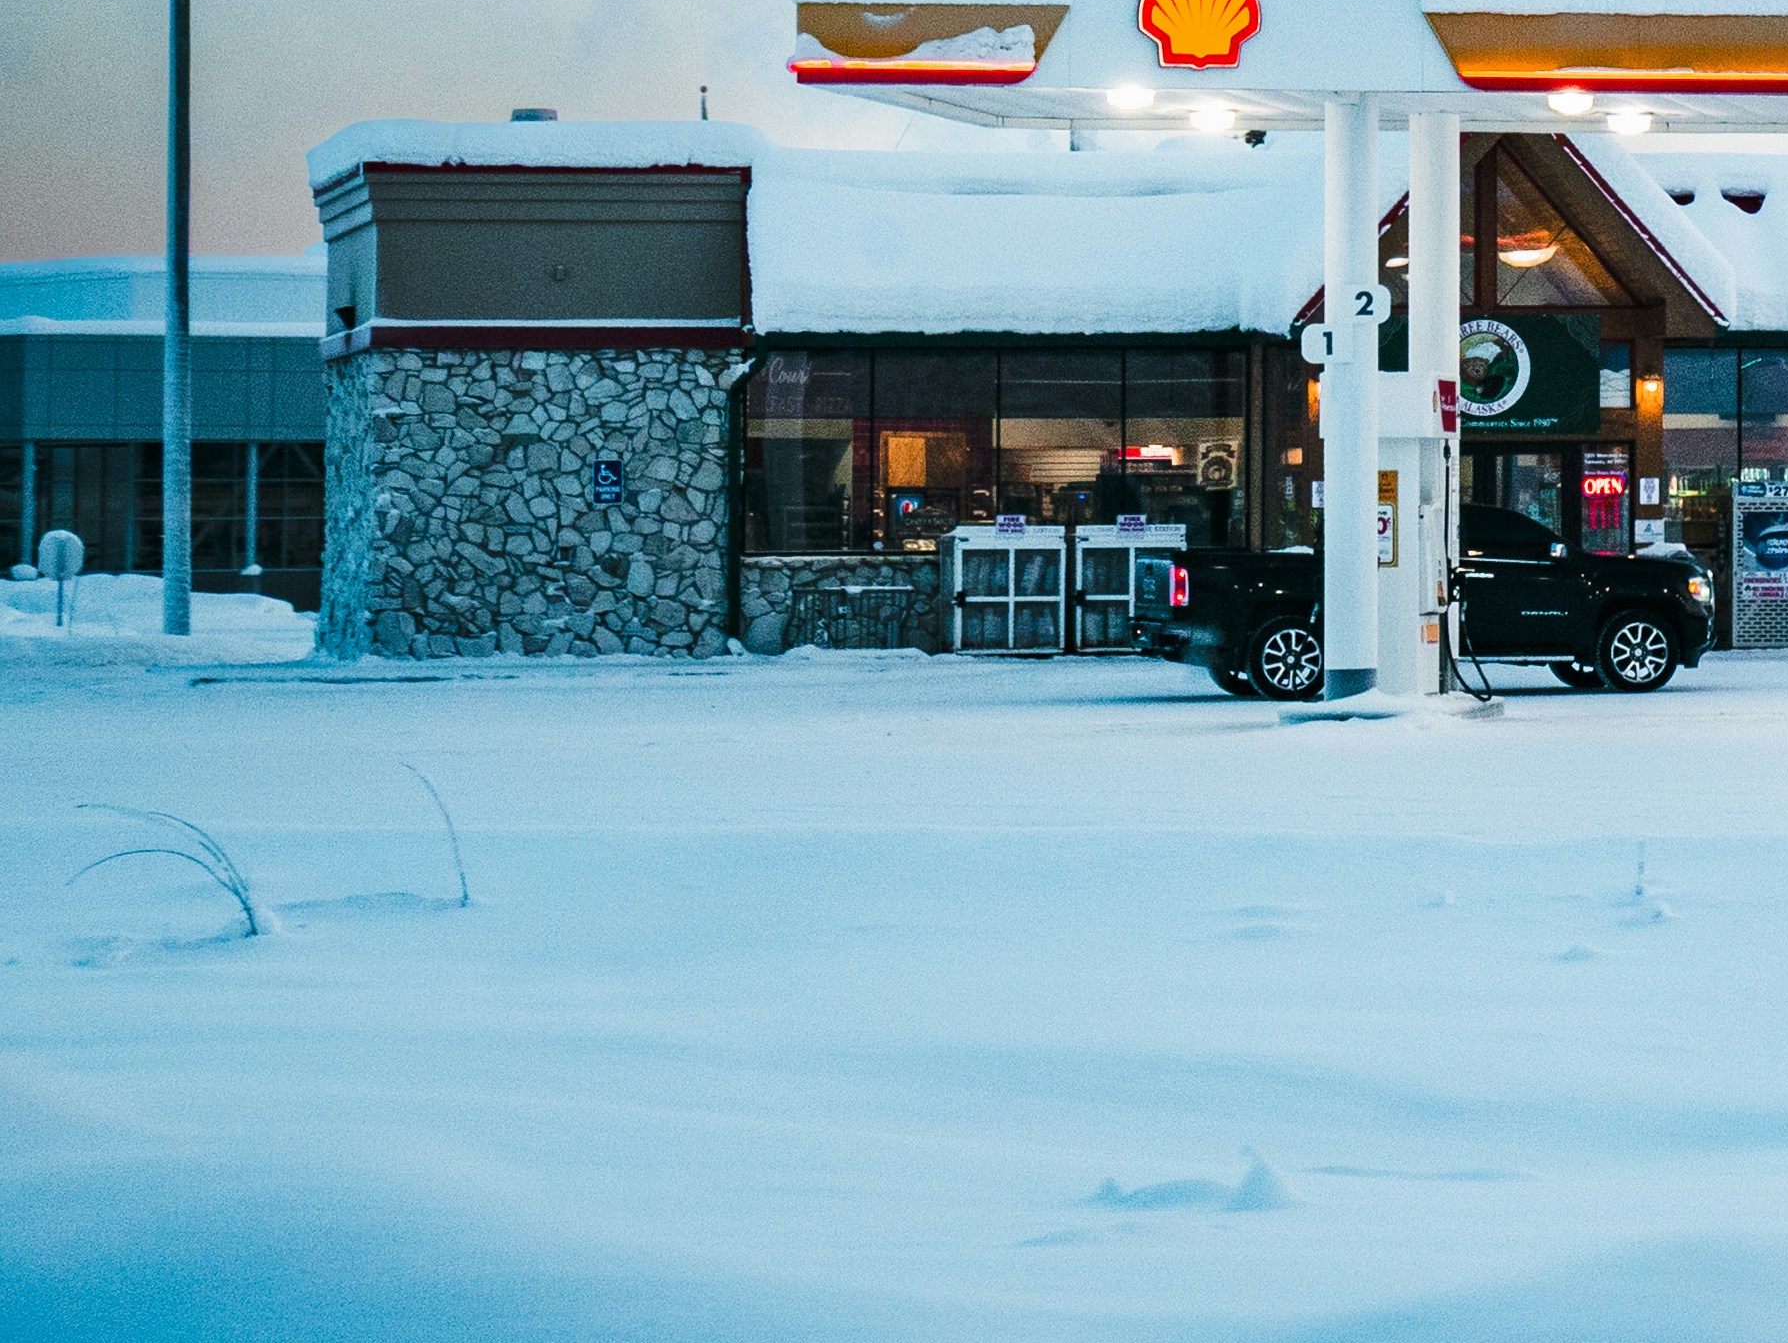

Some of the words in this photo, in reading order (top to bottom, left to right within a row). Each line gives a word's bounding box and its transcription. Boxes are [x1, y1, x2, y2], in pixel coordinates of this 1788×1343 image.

[1355, 291, 1374, 316] 2
[1322, 331, 1333, 355] 1
[1583, 478, 1623, 495] OPEN
